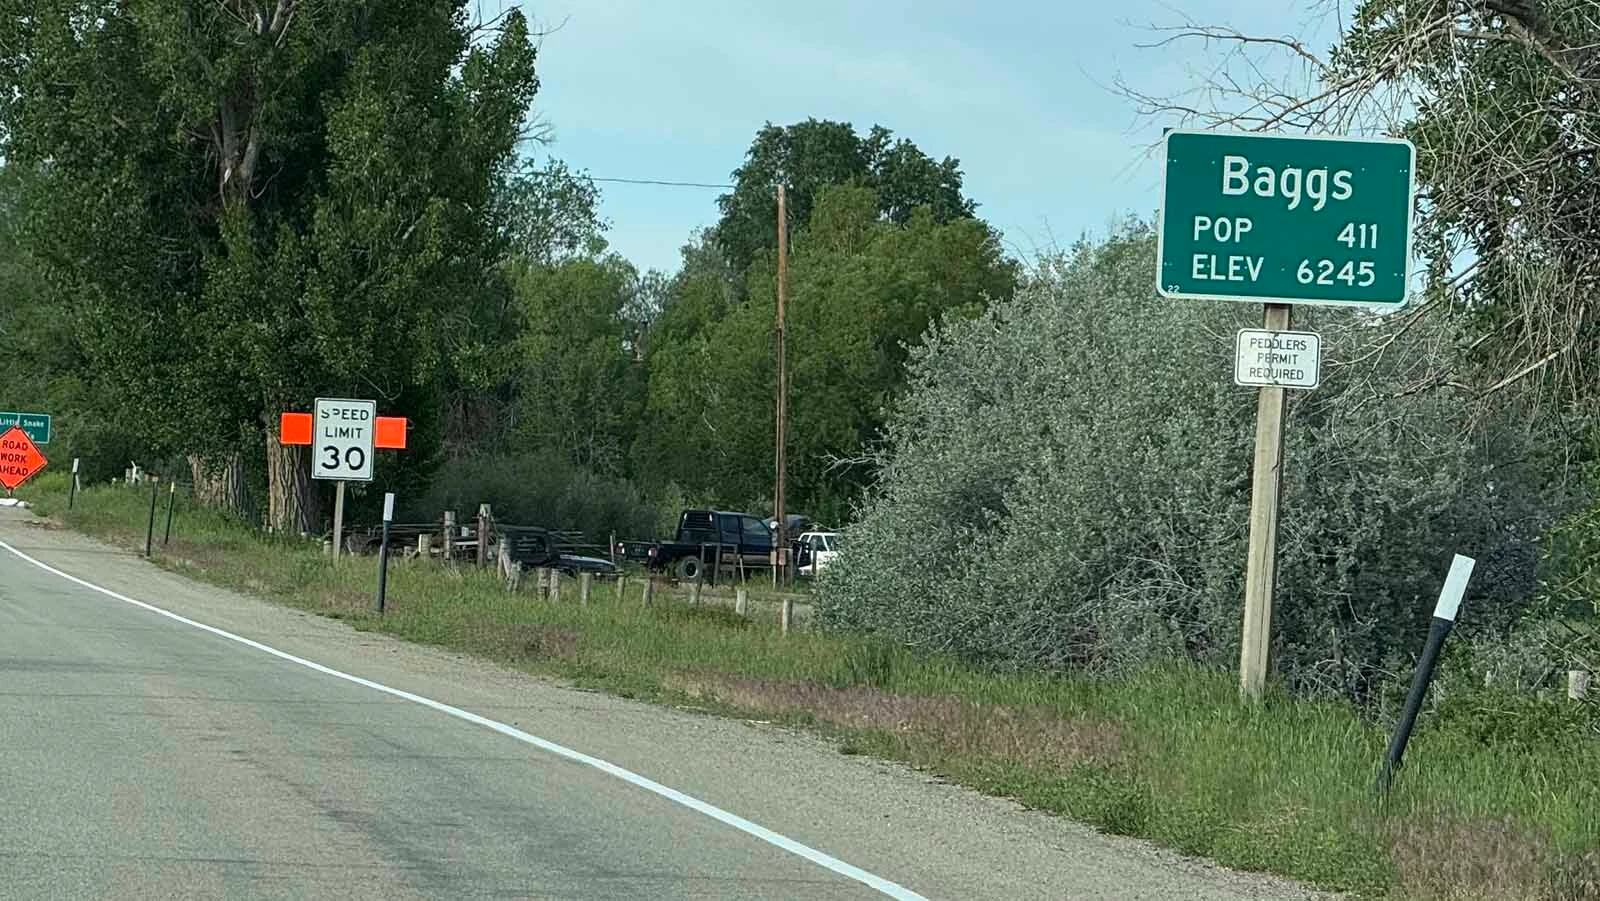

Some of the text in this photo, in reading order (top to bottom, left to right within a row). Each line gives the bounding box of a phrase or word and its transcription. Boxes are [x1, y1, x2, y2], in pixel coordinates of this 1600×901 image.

[1222, 155, 1353, 211] Baggs
[1193, 215, 1378, 249] POP 411
[1191, 253, 1376, 287] ELEV 6245
[1250, 337, 1307, 351] PEDDLERS
[1257, 352, 1299, 365] PERMIT
[1249, 367, 1305, 380] REQUIRED
[321, 408, 369, 420] SPEED
[325, 427, 363, 439] LIMIT
[2, 440, 28, 451] ROAD
[0, 452, 26, 463] WORK
[321, 445, 365, 470] 30
